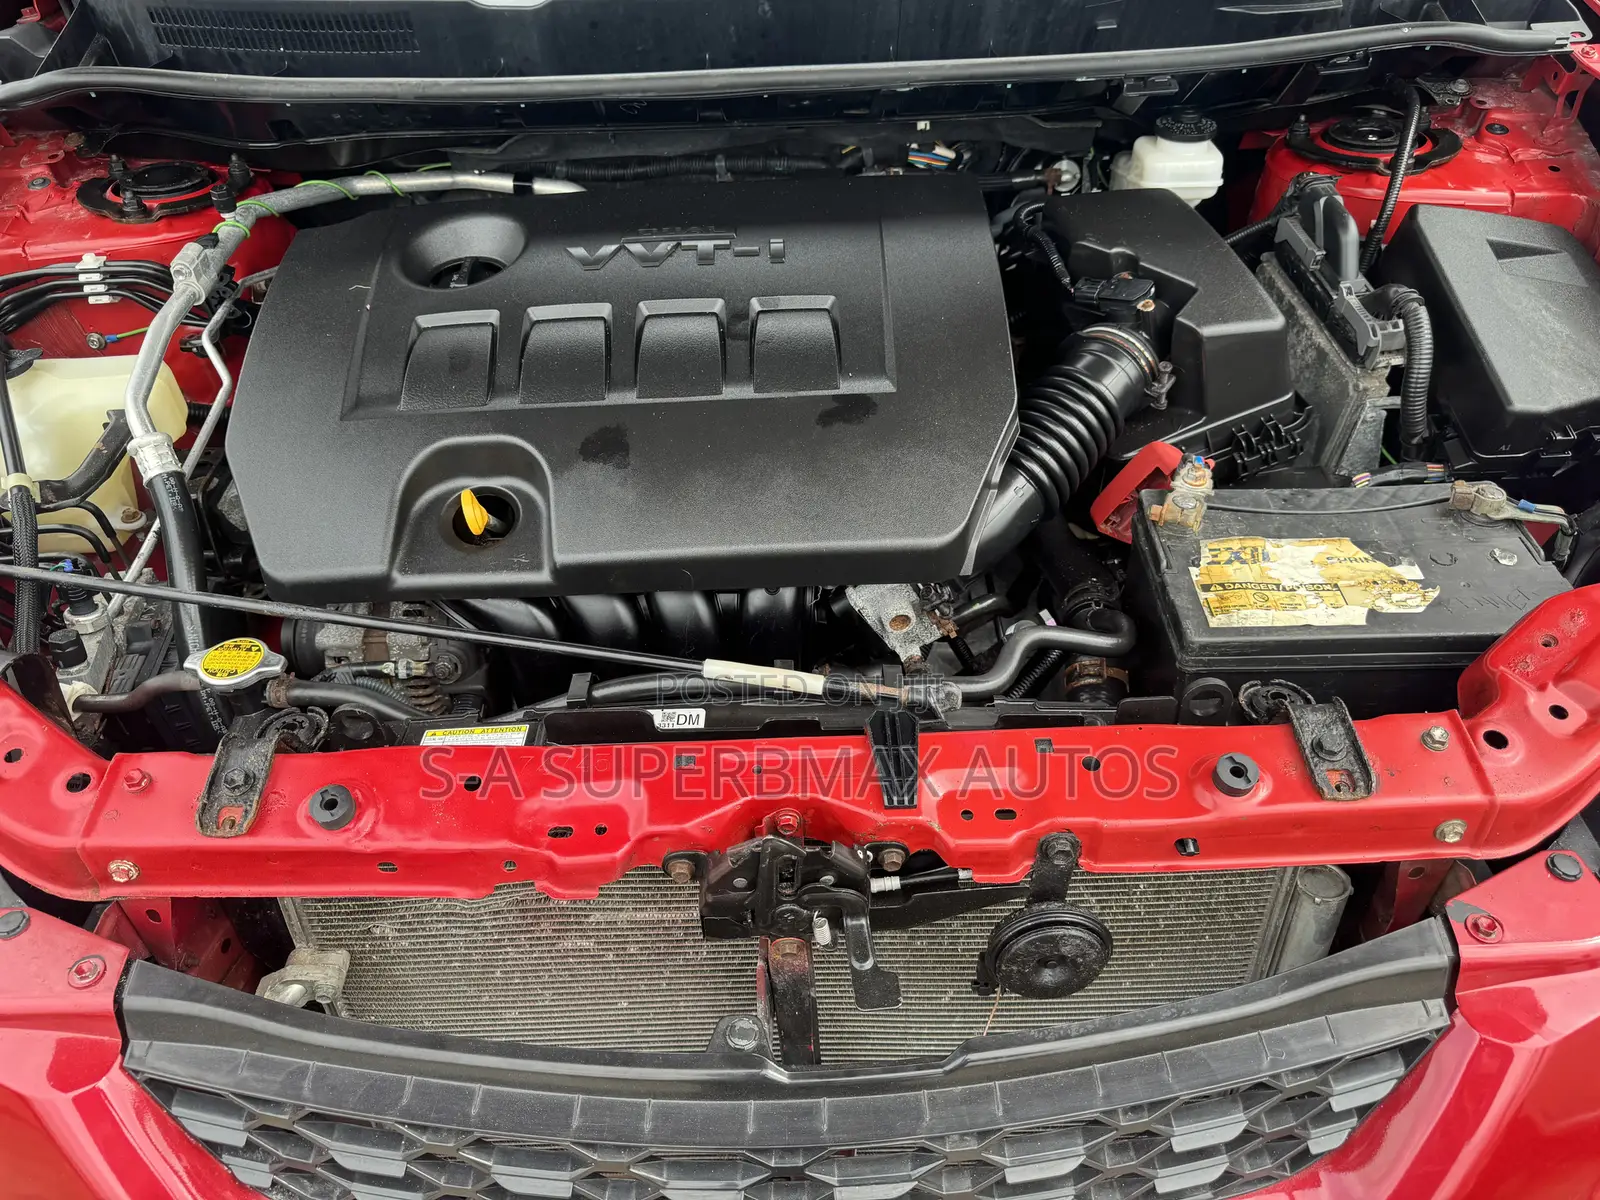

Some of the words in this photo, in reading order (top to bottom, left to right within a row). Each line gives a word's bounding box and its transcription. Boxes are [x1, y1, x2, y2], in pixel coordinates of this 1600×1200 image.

[566, 239, 785, 271] VVT-i
[1224, 582, 1277, 591] DANGER
[676, 713, 700, 726] DM
[442, 728, 475, 736] CAUTION
